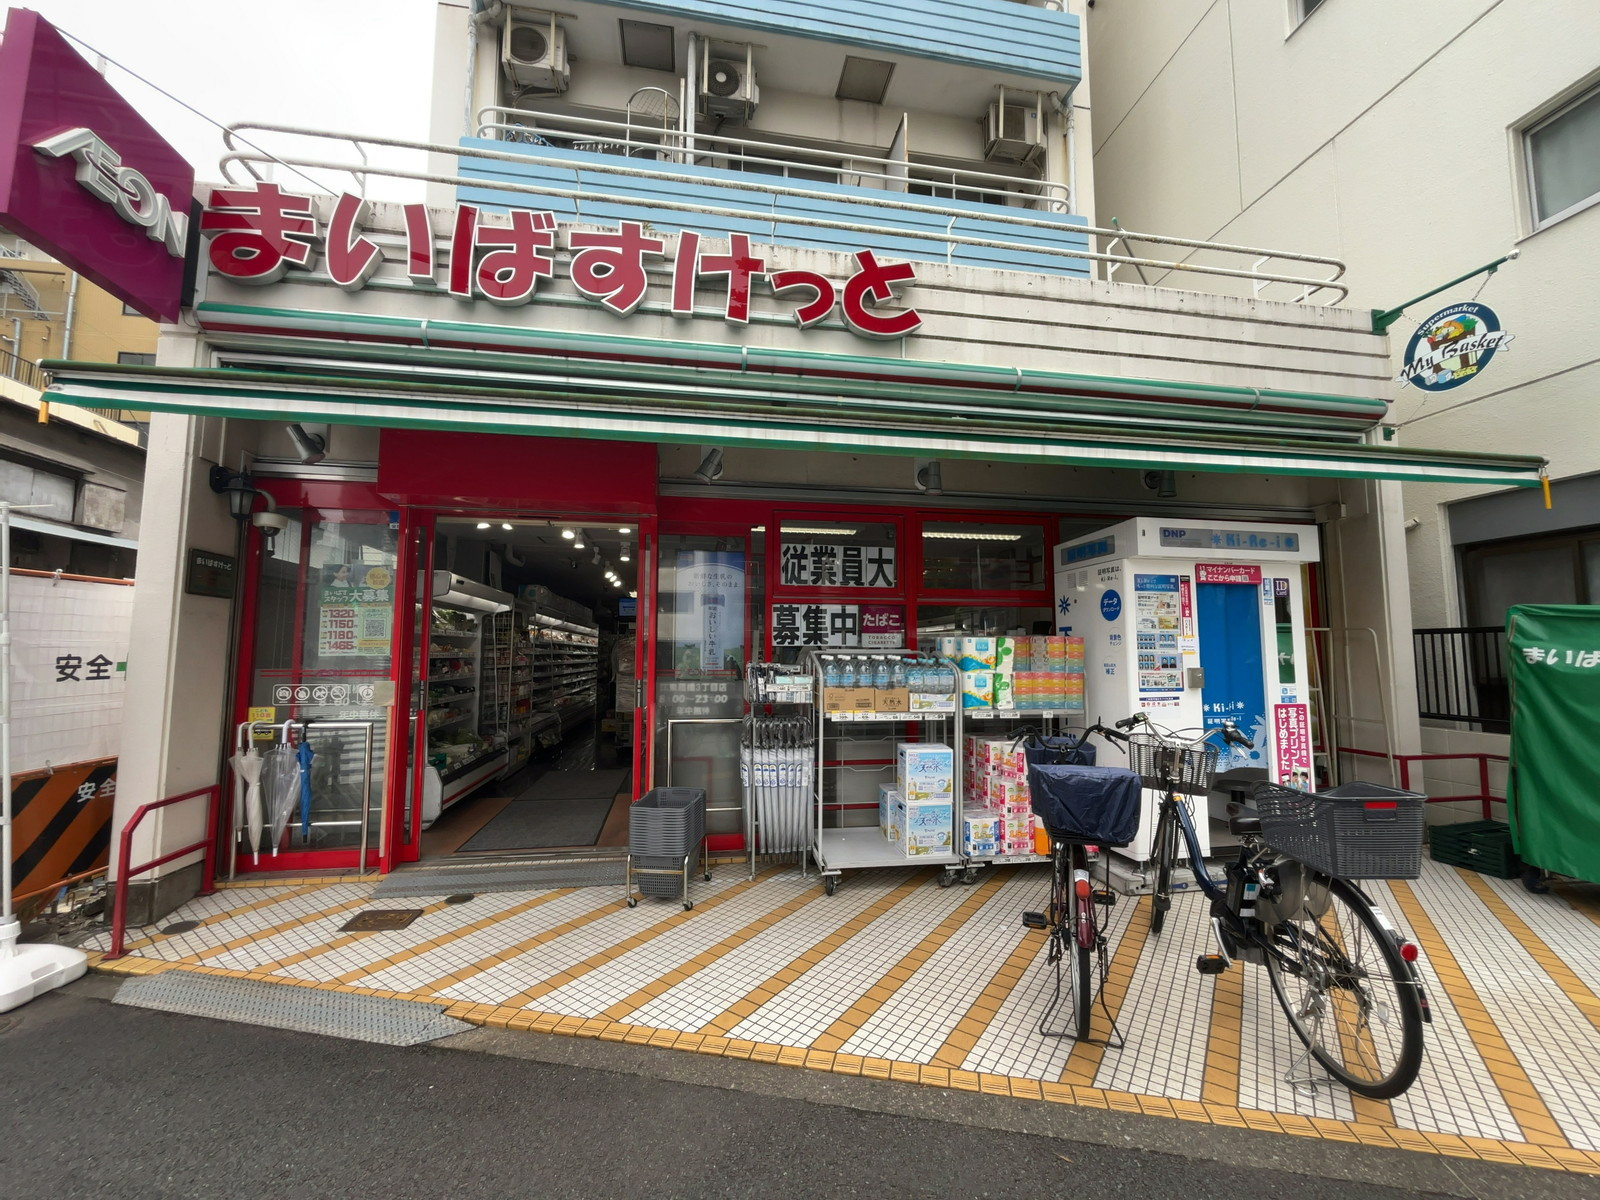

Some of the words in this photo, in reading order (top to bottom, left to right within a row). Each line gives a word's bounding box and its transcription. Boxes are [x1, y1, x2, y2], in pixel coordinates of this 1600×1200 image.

[33, 127, 189, 258] AEON
[201, 182, 923, 338] まいばすけっと
[1417, 304, 1479, 336] Supermarket
[1400, 357, 1434, 379] My
[1442, 332, 1505, 358] Basket
[1163, 529, 1186, 538] DNP
[782, 545, 893, 586] 従業員大
[1206, 566, 1255, 574] マイナンバーカード
[349, 589, 390, 602] 大募集
[1275, 580, 1288, 591] ID
[772, 604, 857, 645] 募集中
[862, 613, 900, 626] たばこ
[55, 653, 113, 683] 安全
[1277, 708, 1290, 770] はじめました
[1287, 707, 1300, 769] 写真プリント
[76, 777, 117, 803] 安全
